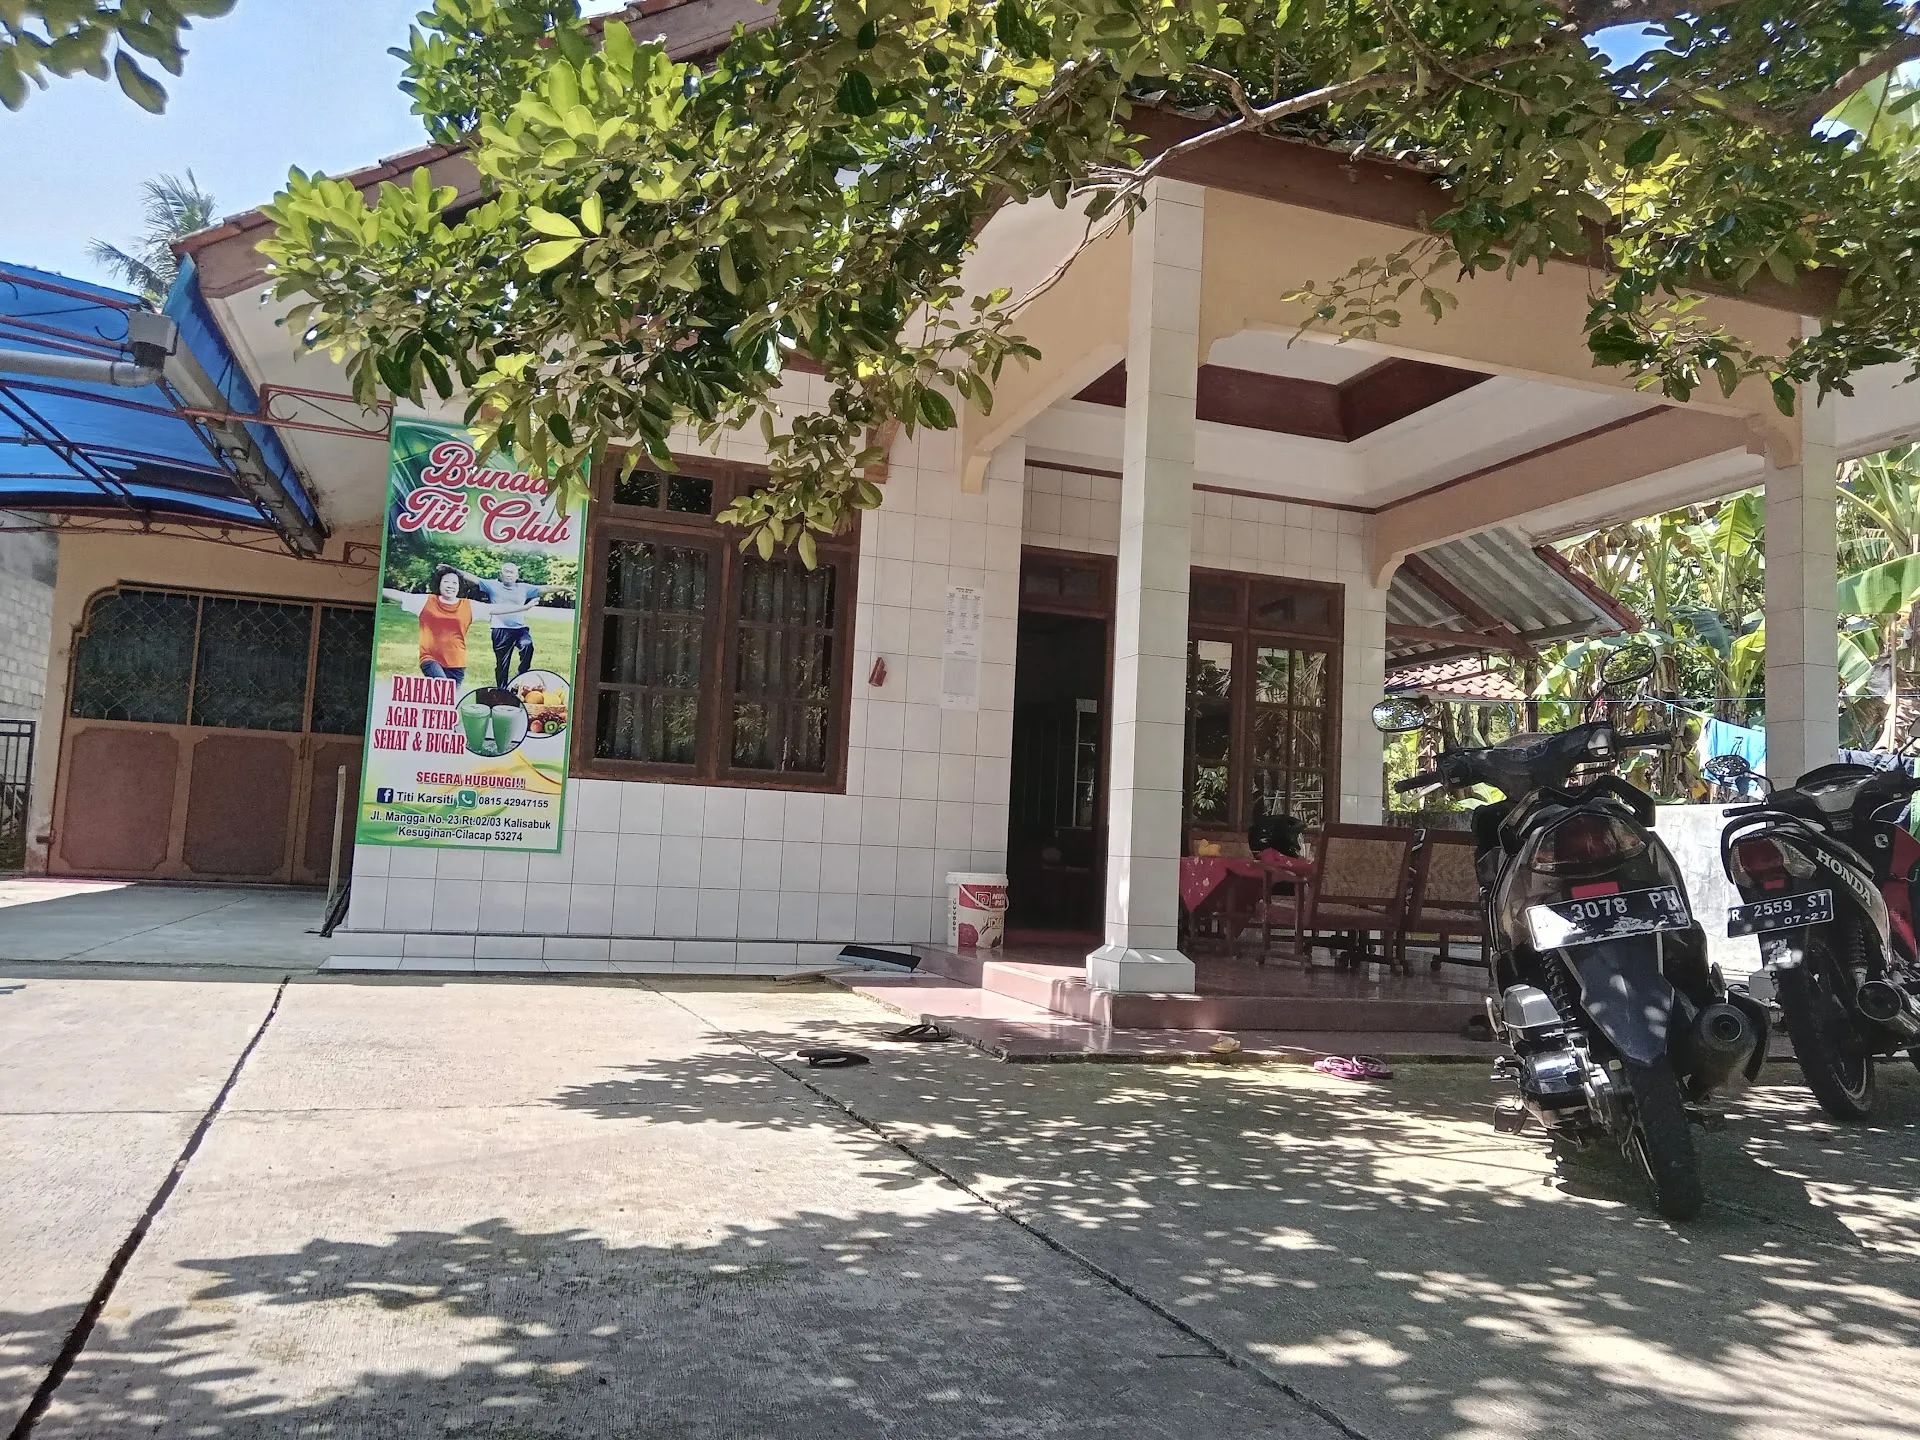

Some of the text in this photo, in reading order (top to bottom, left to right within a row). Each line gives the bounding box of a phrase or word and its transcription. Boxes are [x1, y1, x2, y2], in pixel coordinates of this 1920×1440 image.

[399, 488, 571, 543] Titi Club
[392, 675, 455, 706] RAHASIA
[385, 706, 458, 730] AGAR TETAP
[373, 728, 465, 755] SEHAT & BUGAR
[416, 771, 526, 789] SEGERA HUBUNGI!!
[397, 791, 454, 805] Titi Karsiti
[478, 797, 549, 808] 0815 42947155
[370, 812, 382, 821] Jl.
[385, 812, 425, 825] Mangga
[428, 814, 445, 824] No.
[447, 815, 459, 825] 23
[504, 818, 551, 830] Kalisabuk
[398, 826, 523, 843] Kesugihan-Cilacap 53274
[1815, 847, 1872, 907] HONDA
[1570, 897, 1628, 921] 3078
[1731, 892, 1828, 921] R 2559 ST
